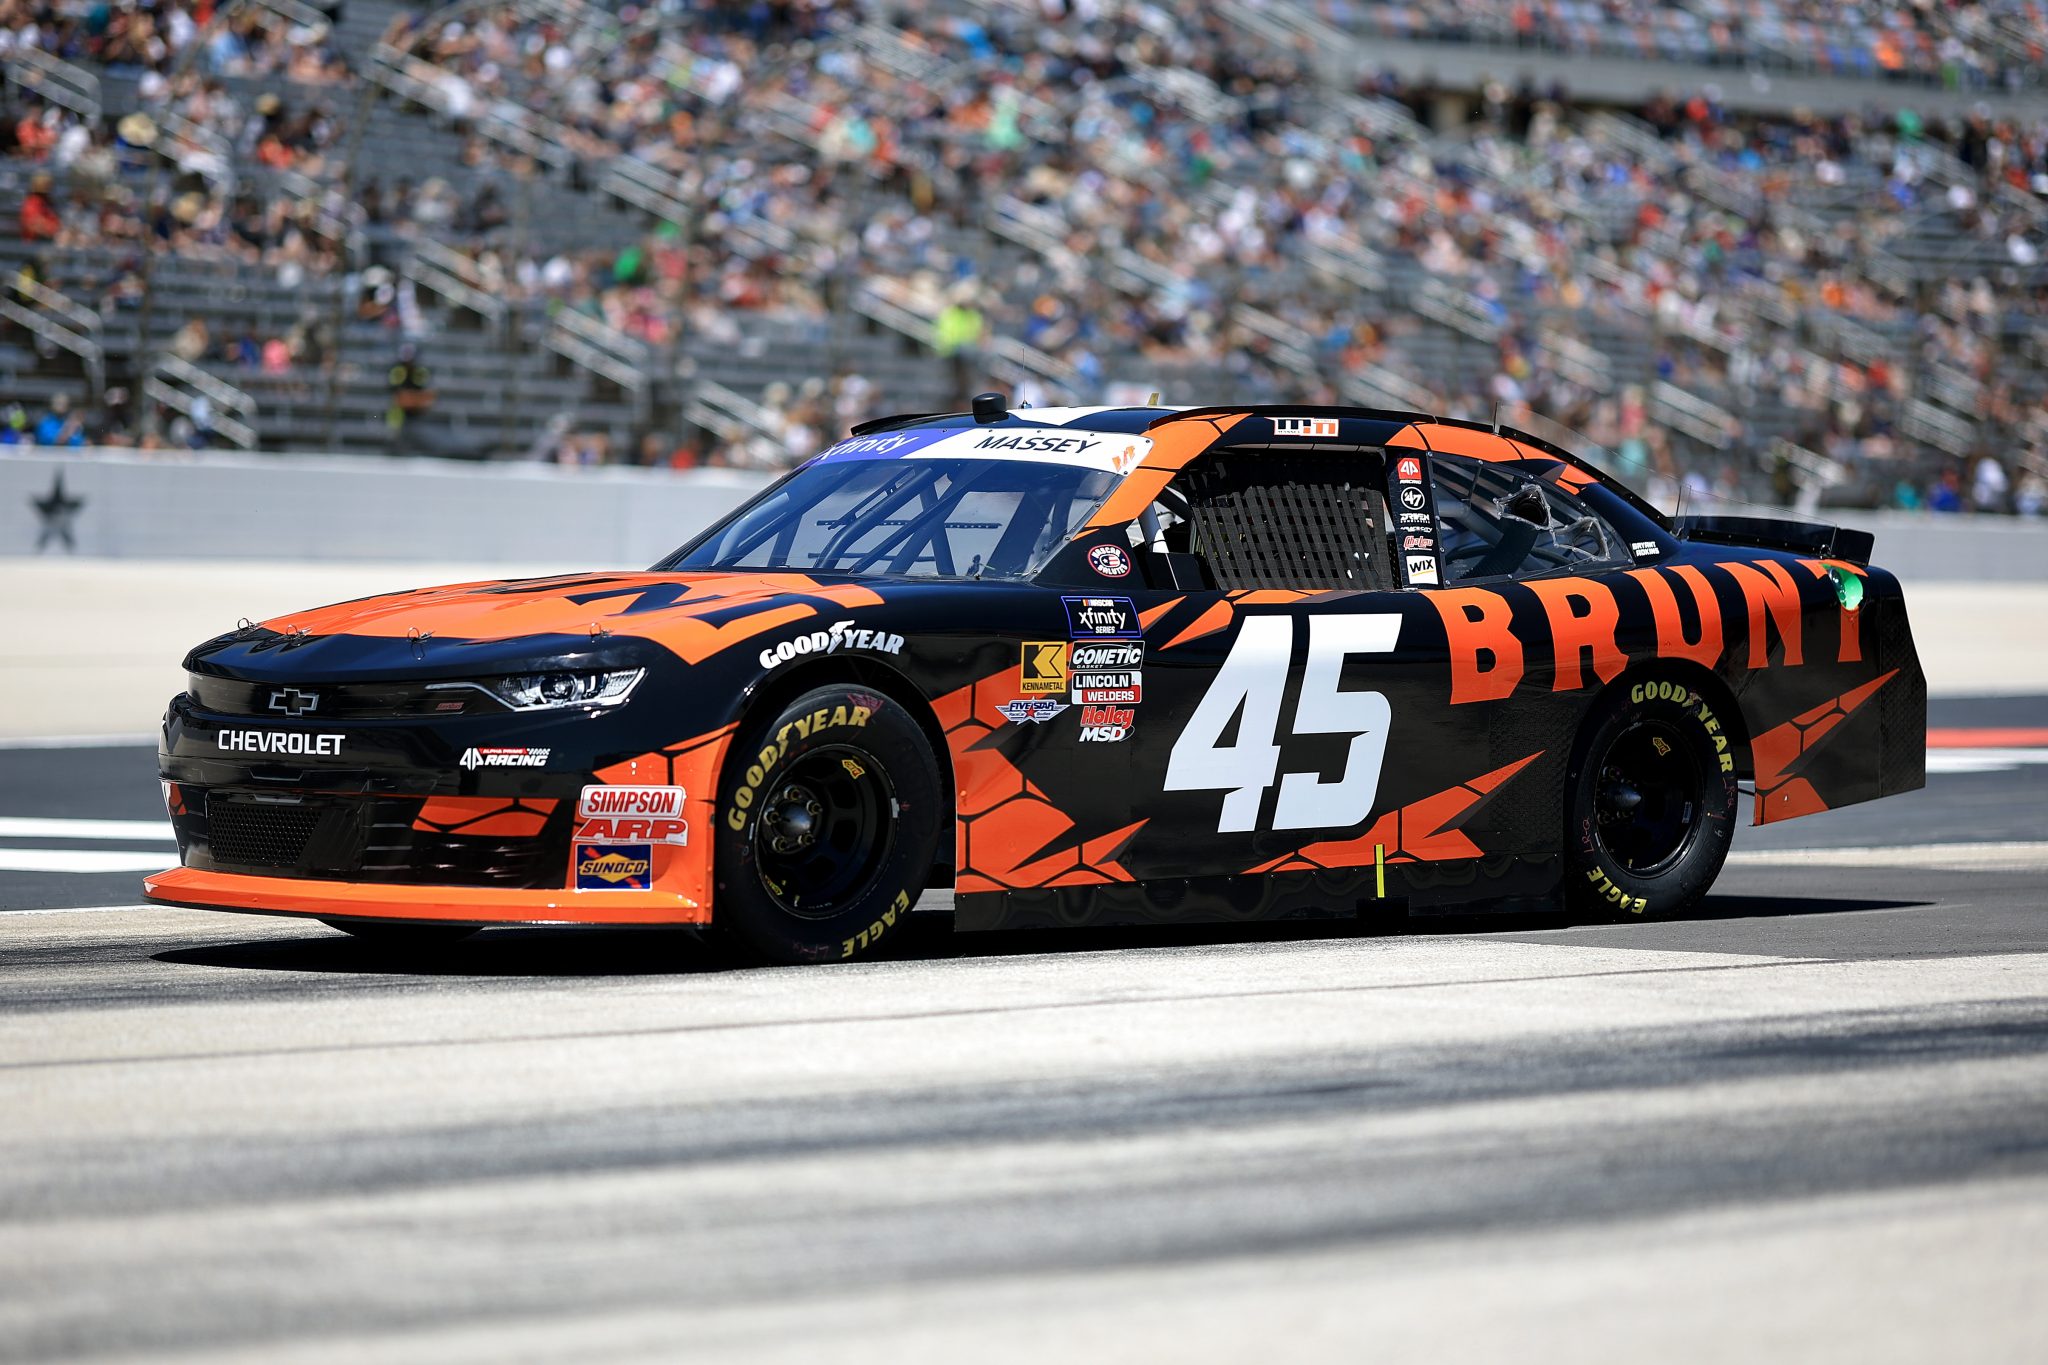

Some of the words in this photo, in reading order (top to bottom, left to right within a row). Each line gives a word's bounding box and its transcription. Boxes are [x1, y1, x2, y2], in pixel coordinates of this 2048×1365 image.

[973, 435, 1101, 454] MASSEY
[1404, 490, 1422, 507] 47
[1091, 546, 1121, 559] NASCAR
[1097, 563, 1128, 575] SALUTES
[1409, 558, 1434, 573] WIX
[1089, 599, 1115, 607] NASCAR
[1078, 607, 1126, 630] xfinity
[1095, 626, 1116, 634] SERIES
[759, 620, 905, 670] GOODYEAR
[1072, 645, 1142, 665] COMETIC
[1022, 681, 1064, 691] KENNAMETAL
[1075, 674, 1129, 688] LINCOLN
[1087, 690, 1135, 702] WELDERS
[1009, 702, 1032, 711] FIVE
[1032, 702, 1055, 711] STAR
[1081, 705, 1135, 729] Holley
[1162, 612, 1403, 834] 45
[217, 729, 346, 756] CHEVROLET
[1079, 727, 1126, 743] MSD
[484, 754, 549, 767] RACING
[727, 705, 872, 832] GOODYEAR
[587, 790, 676, 814] SIMPSON
[577, 819, 687, 839] ARP
[581, 860, 647, 875] SUNOCO
[1586, 865, 1648, 915] EAGLE
[841, 889, 911, 959] EAGLE
